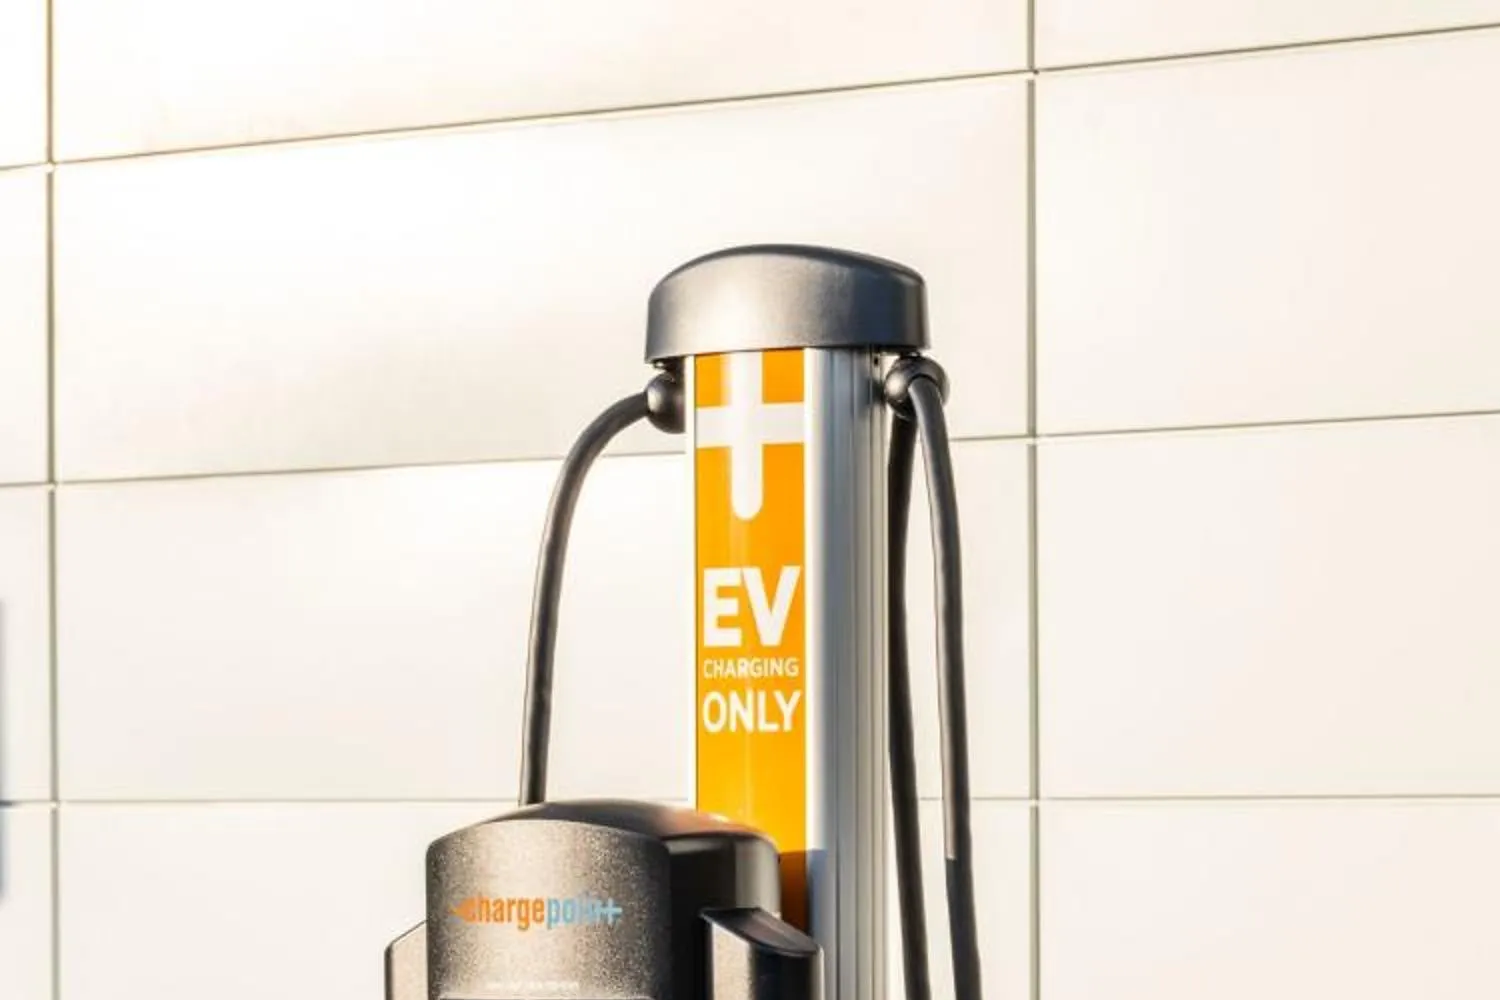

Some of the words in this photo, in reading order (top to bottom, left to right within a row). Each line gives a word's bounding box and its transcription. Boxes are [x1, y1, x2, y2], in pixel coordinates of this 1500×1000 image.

[703, 565, 801, 647] EV
[703, 656, 799, 678] CHARGING
[702, 690, 801, 733] ONLY
